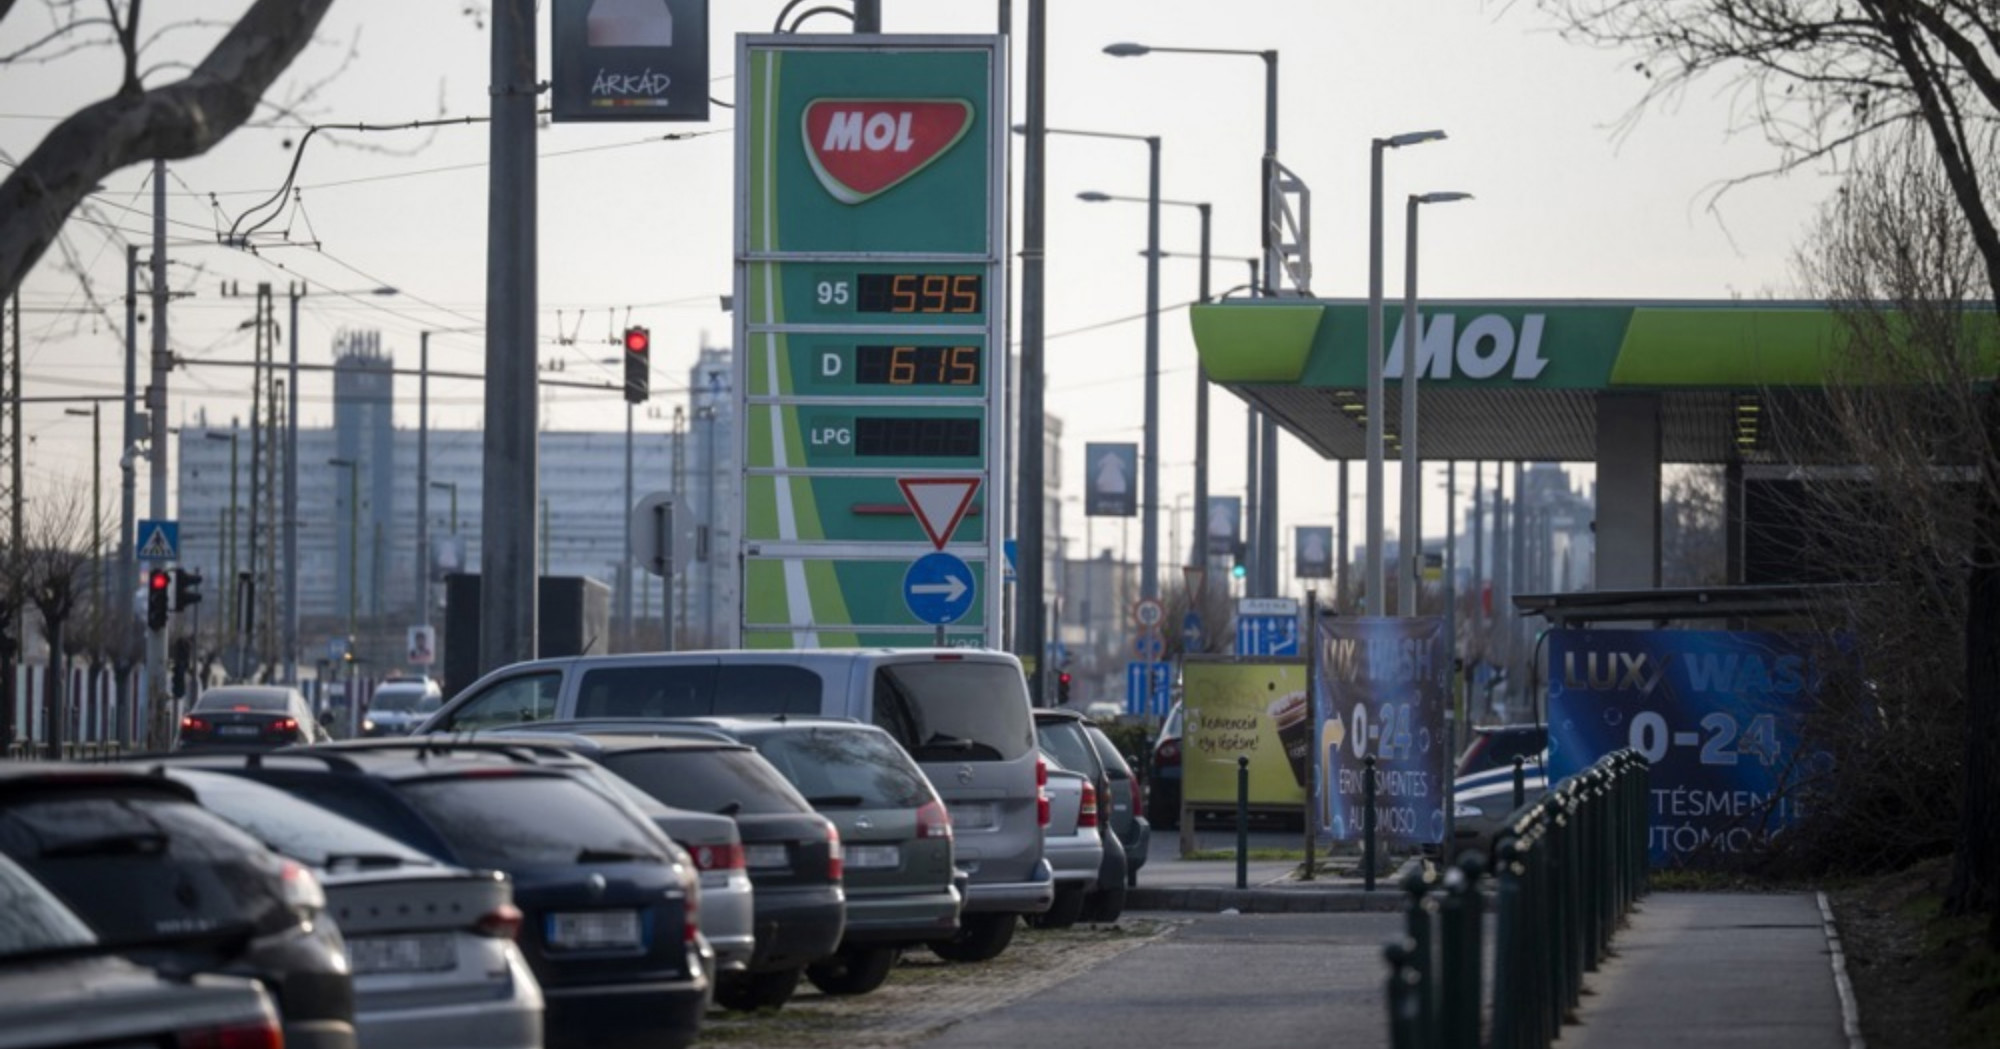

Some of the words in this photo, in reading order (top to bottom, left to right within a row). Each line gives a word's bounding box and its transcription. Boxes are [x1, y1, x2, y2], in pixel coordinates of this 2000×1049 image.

[592, 68, 671, 95] ÁRKÁD
[822, 111, 915, 152] MOL
[817, 281, 848, 304] 95
[891, 275, 977, 312] 595
[822, 353, 842, 376] D
[889, 346, 977, 384] 615
[1383, 313, 1549, 379] MOL
[811, 428, 851, 445] LPG
[1682, 653, 1818, 692] WAS
[1352, 703, 1412, 760] 0-24
[1629, 711, 1780, 765] 0-24
